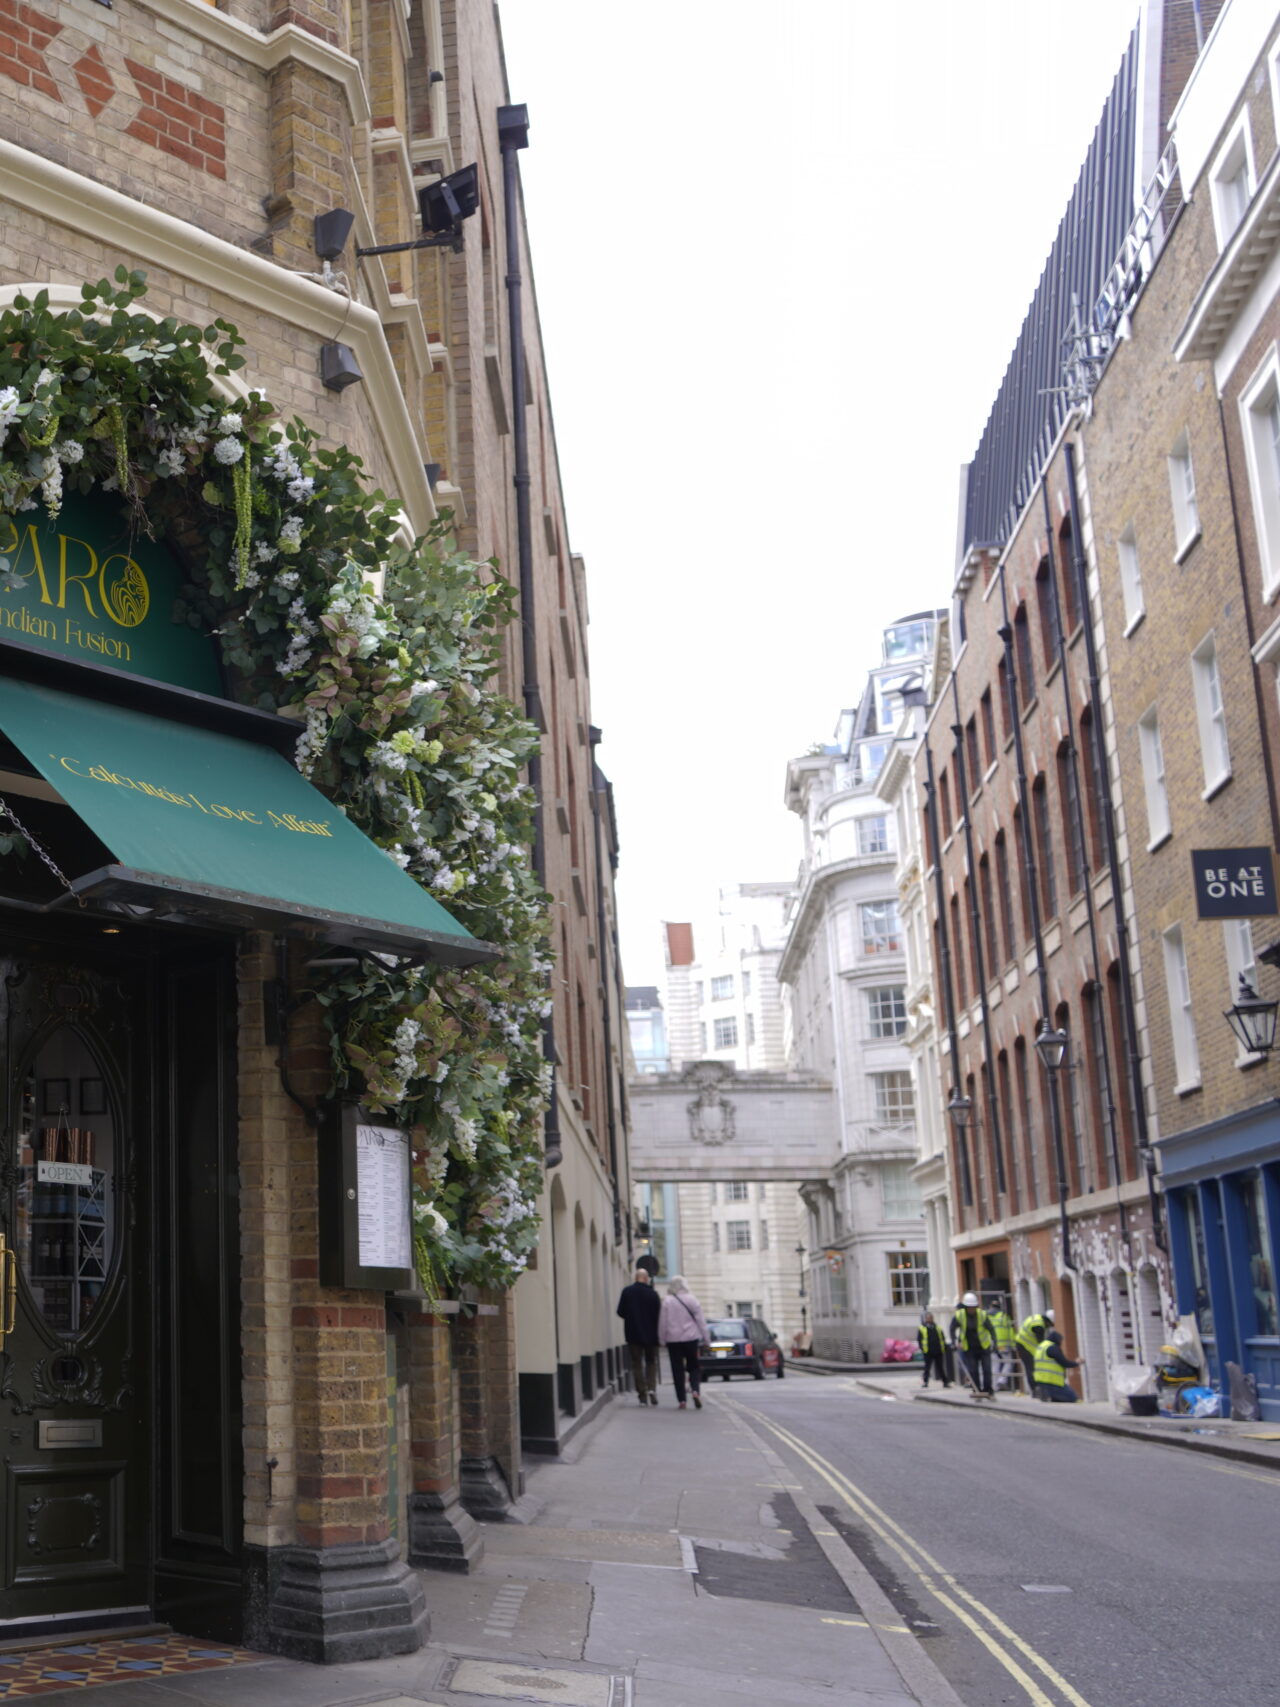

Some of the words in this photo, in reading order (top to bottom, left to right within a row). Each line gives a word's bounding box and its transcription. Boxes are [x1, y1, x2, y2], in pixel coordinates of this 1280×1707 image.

[65, 619, 131, 661] Fusion
[188, 793, 263, 825] Love
[1204, 868, 1228, 882] BE
[1238, 866, 1263, 880] AT
[1207, 880, 1265, 898] ONE
[48, 1166, 83, 1180] OPEN
